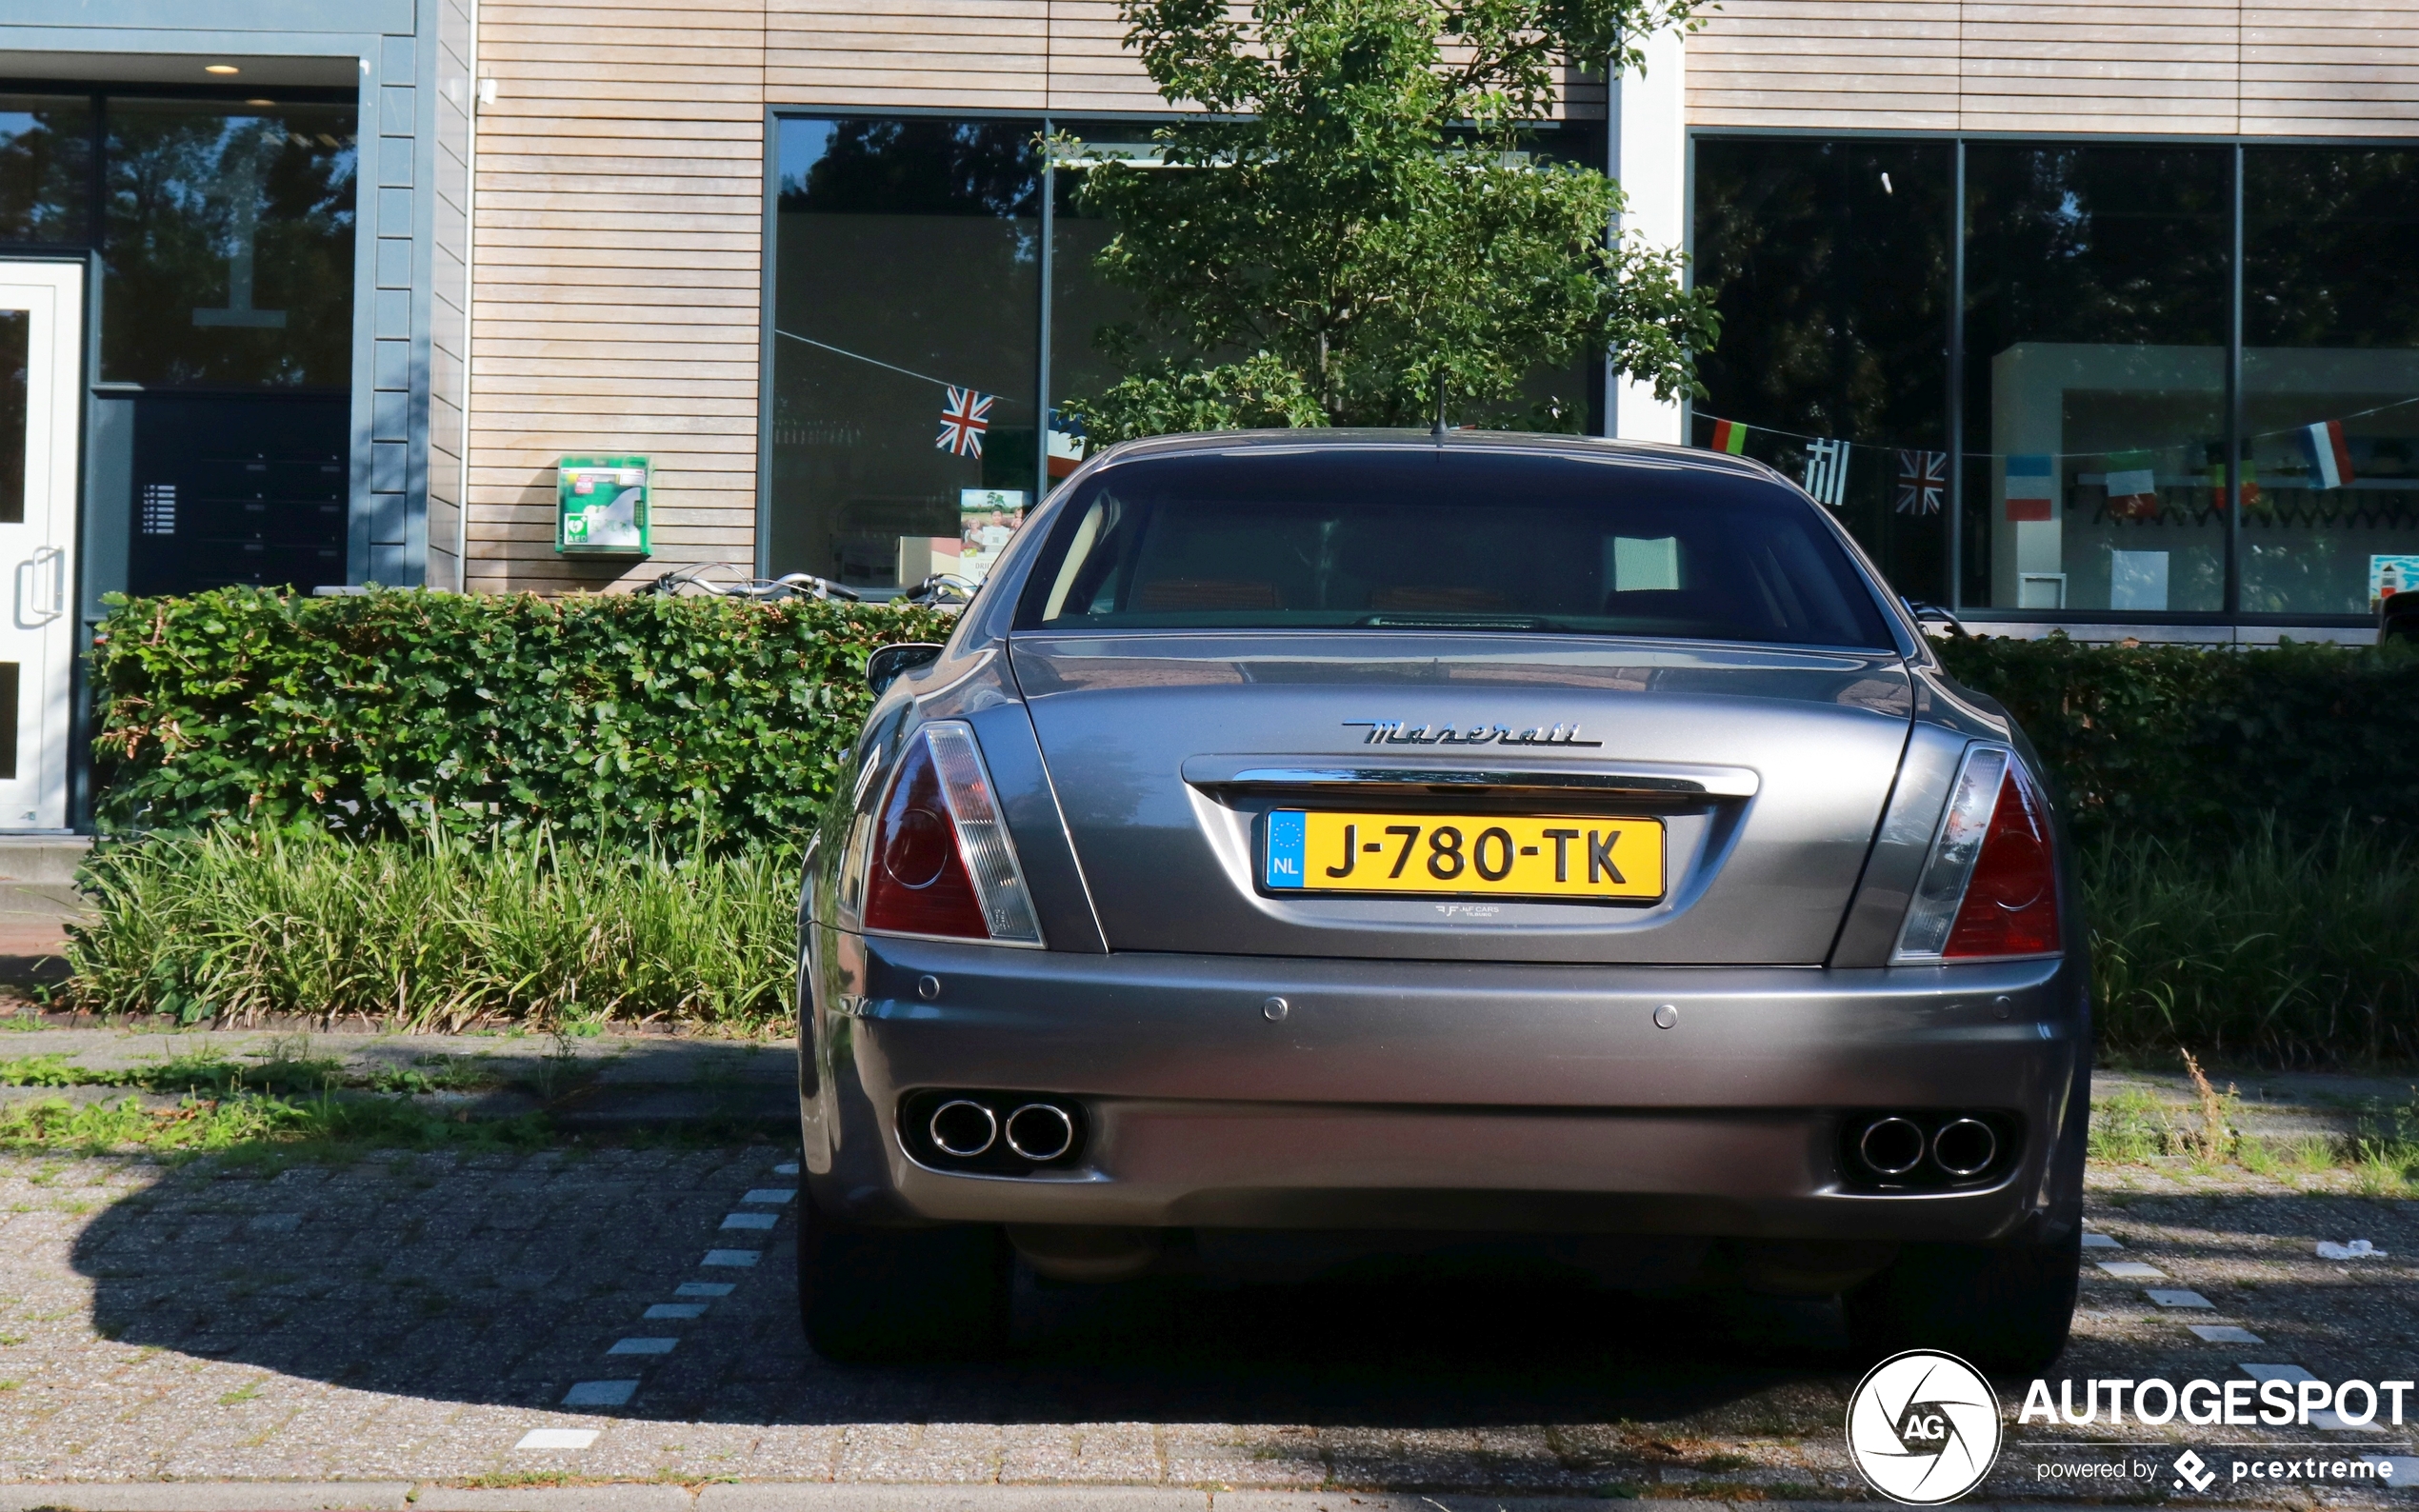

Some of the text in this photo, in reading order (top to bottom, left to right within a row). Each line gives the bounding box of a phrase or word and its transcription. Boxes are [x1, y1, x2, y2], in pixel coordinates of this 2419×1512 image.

[1341, 719, 1605, 747] Maserati
[1273, 858, 1299, 875] NL
[1326, 825, 1627, 885] J-780-TK
